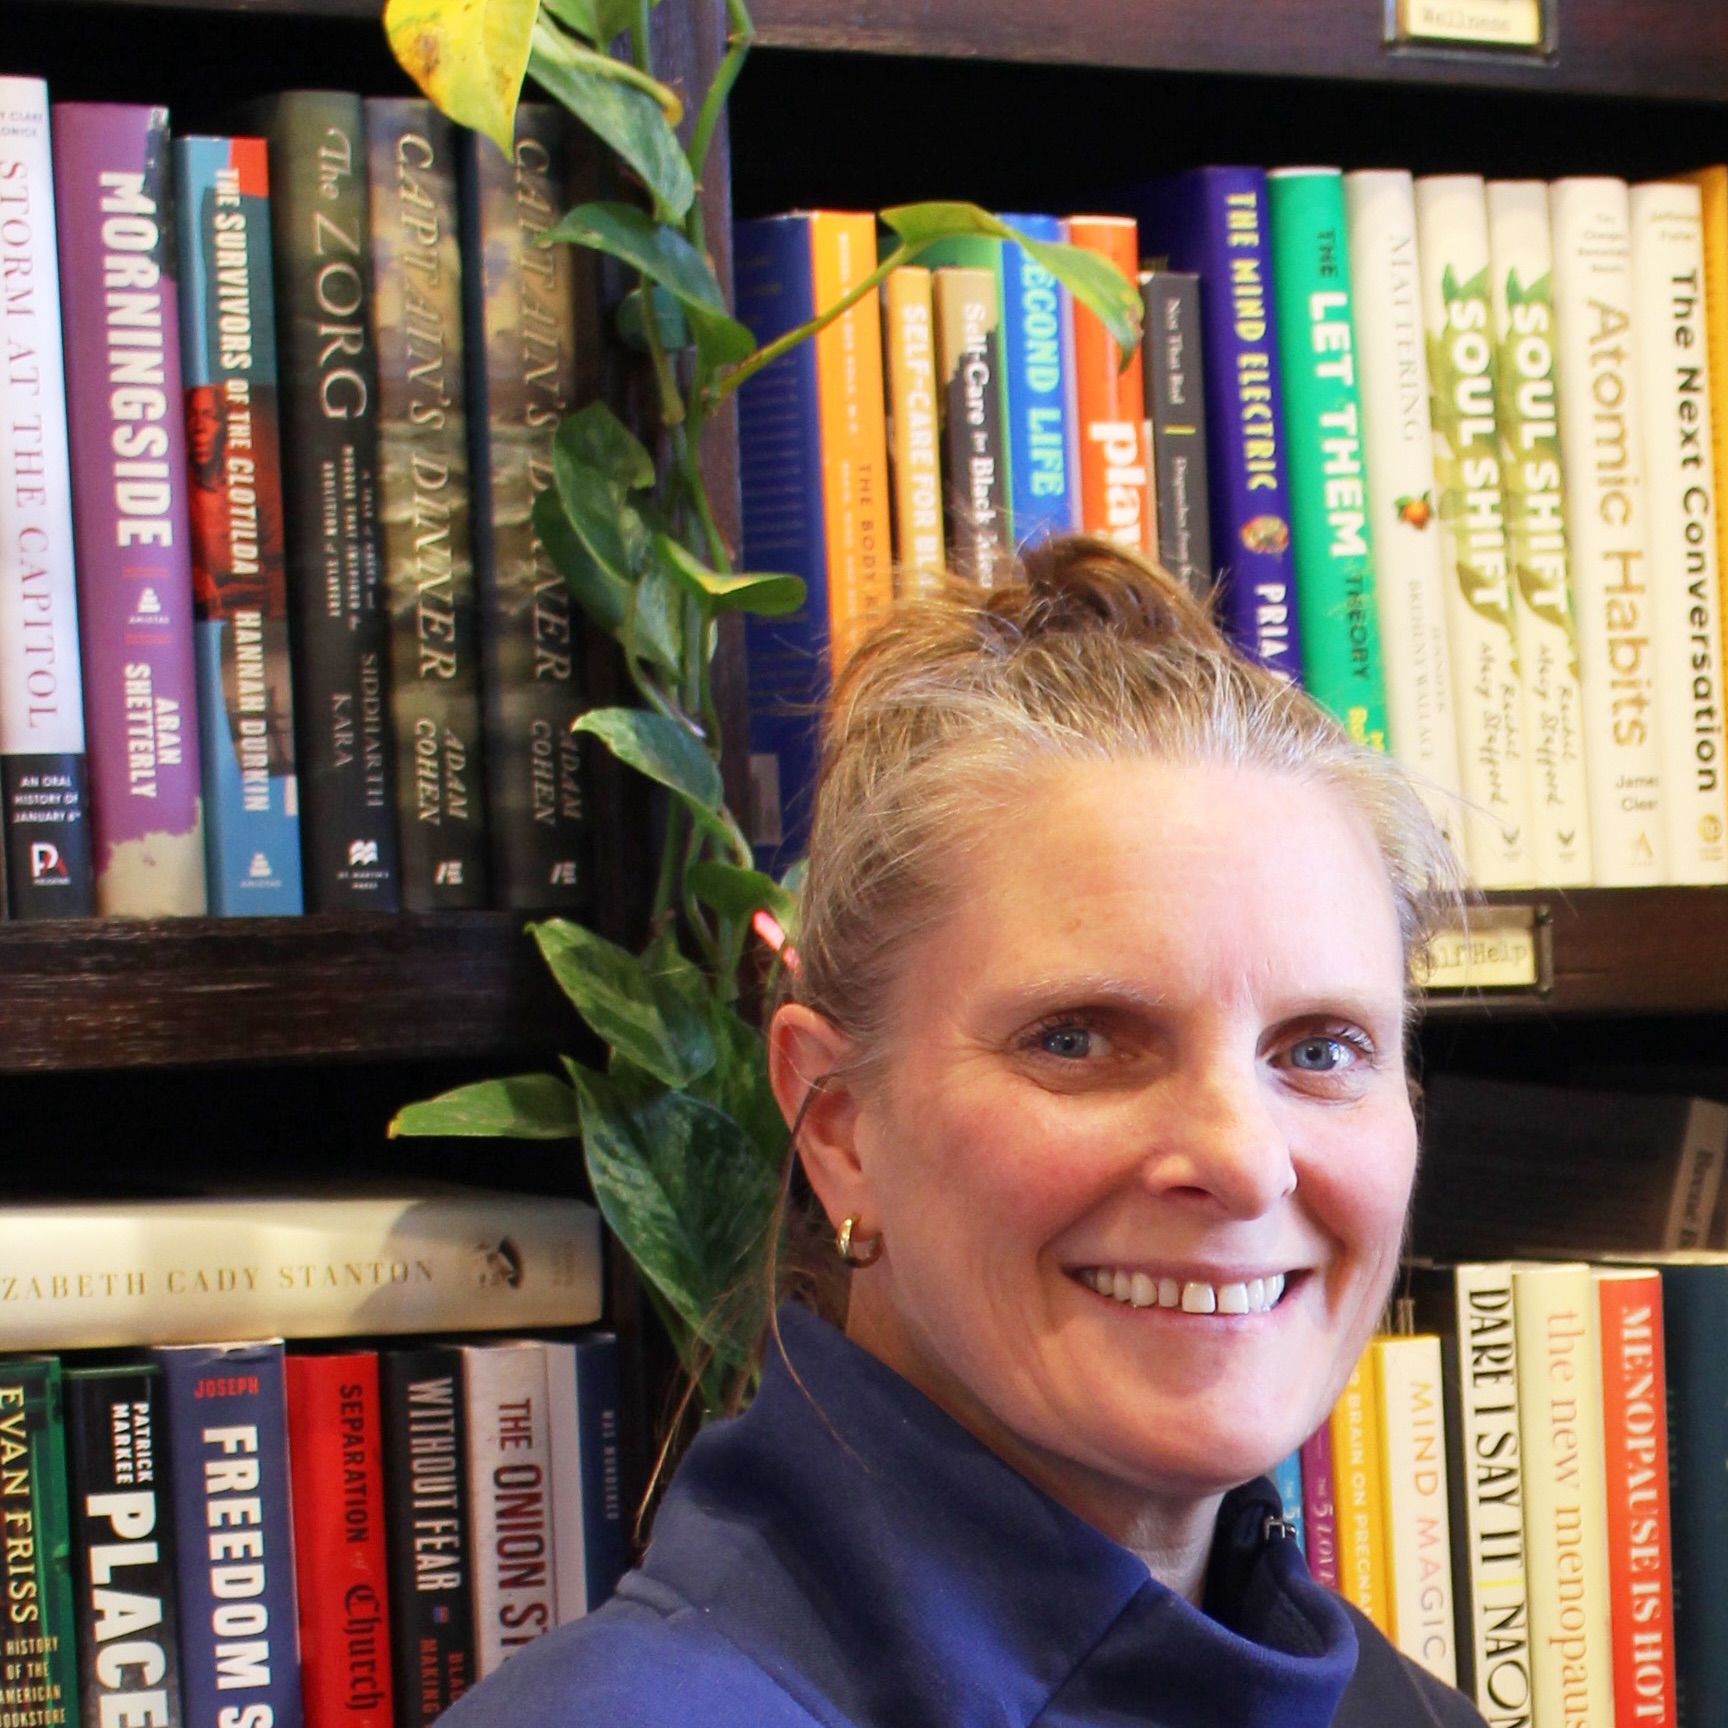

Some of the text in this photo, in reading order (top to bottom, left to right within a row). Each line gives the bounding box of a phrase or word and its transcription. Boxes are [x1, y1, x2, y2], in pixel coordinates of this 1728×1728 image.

[0, 162, 36, 317] STORM
[313, 128, 368, 419] The ZORG
[1317, 228, 1338, 278] THE
[7, 338, 40, 396] AT
[100, 171, 173, 547] MORNINGSIDE
[1224, 192, 1278, 491] THE MIND ELECTRIC
[1309, 291, 1353, 387] LET
[1671, 270, 1698, 350] The
[216, 168, 259, 575] THE SURVIVORS OF THE CLOTILDA
[398, 133, 457, 679] CAPTAIN'S DINNER
[902, 303, 938, 538] SELF-CARE FOR
[1584, 297, 1640, 528] Atomic
[1675, 366, 1704, 470] Next
[13, 414, 46, 508] THE
[1027, 408, 1064, 497] LIFE
[1319, 404, 1367, 558] THEM
[1449, 300, 1507, 612] SOUL SHIFT
[1513, 303, 1566, 608] SOUL SHIFT
[17, 526, 58, 729] CAPITOL
[1345, 574, 1369, 680] THEORY
[1602, 550, 1651, 748] Habits
[1682, 486, 1723, 792] Conversation
[124, 664, 157, 797] SHETTERLY
[156, 697, 182, 765] ARAN
[235, 611, 269, 812] HANNAH DURKIN
[332, 692, 353, 768] KARA
[12, 811, 65, 823] JANUARY
[14, 794, 62, 805] HISTORY
[20, 775, 71, 787] AN ORAL
[414, 718, 441, 825] COHEN
[445, 728, 468, 821] ADAM
[167, 1258, 434, 1294] CADY STANTON
[1546, 1309, 1587, 1386] the
[111, 1404, 133, 1485] MARKEE
[132, 1402, 152, 1483] PATRICK
[340, 1384, 368, 1544] SEPARATION
[498, 1398, 532, 1451] THE
[1467, 1288, 1523, 1569] DARE I SAY IT
[1549, 1399, 1581, 1490] new
[409, 1377, 462, 1593] WITHOUT FEAR
[494, 1463, 548, 1590] ONION
[1351, 1472, 1368, 1505] ON
[1409, 1380, 1447, 1660] MIND MAGIC
[1621, 1306, 1666, 1725] MENOPAUSE IS HOT
[4, 1512, 38, 1624] FRISS
[202, 1424, 272, 1691] FREEDOM
